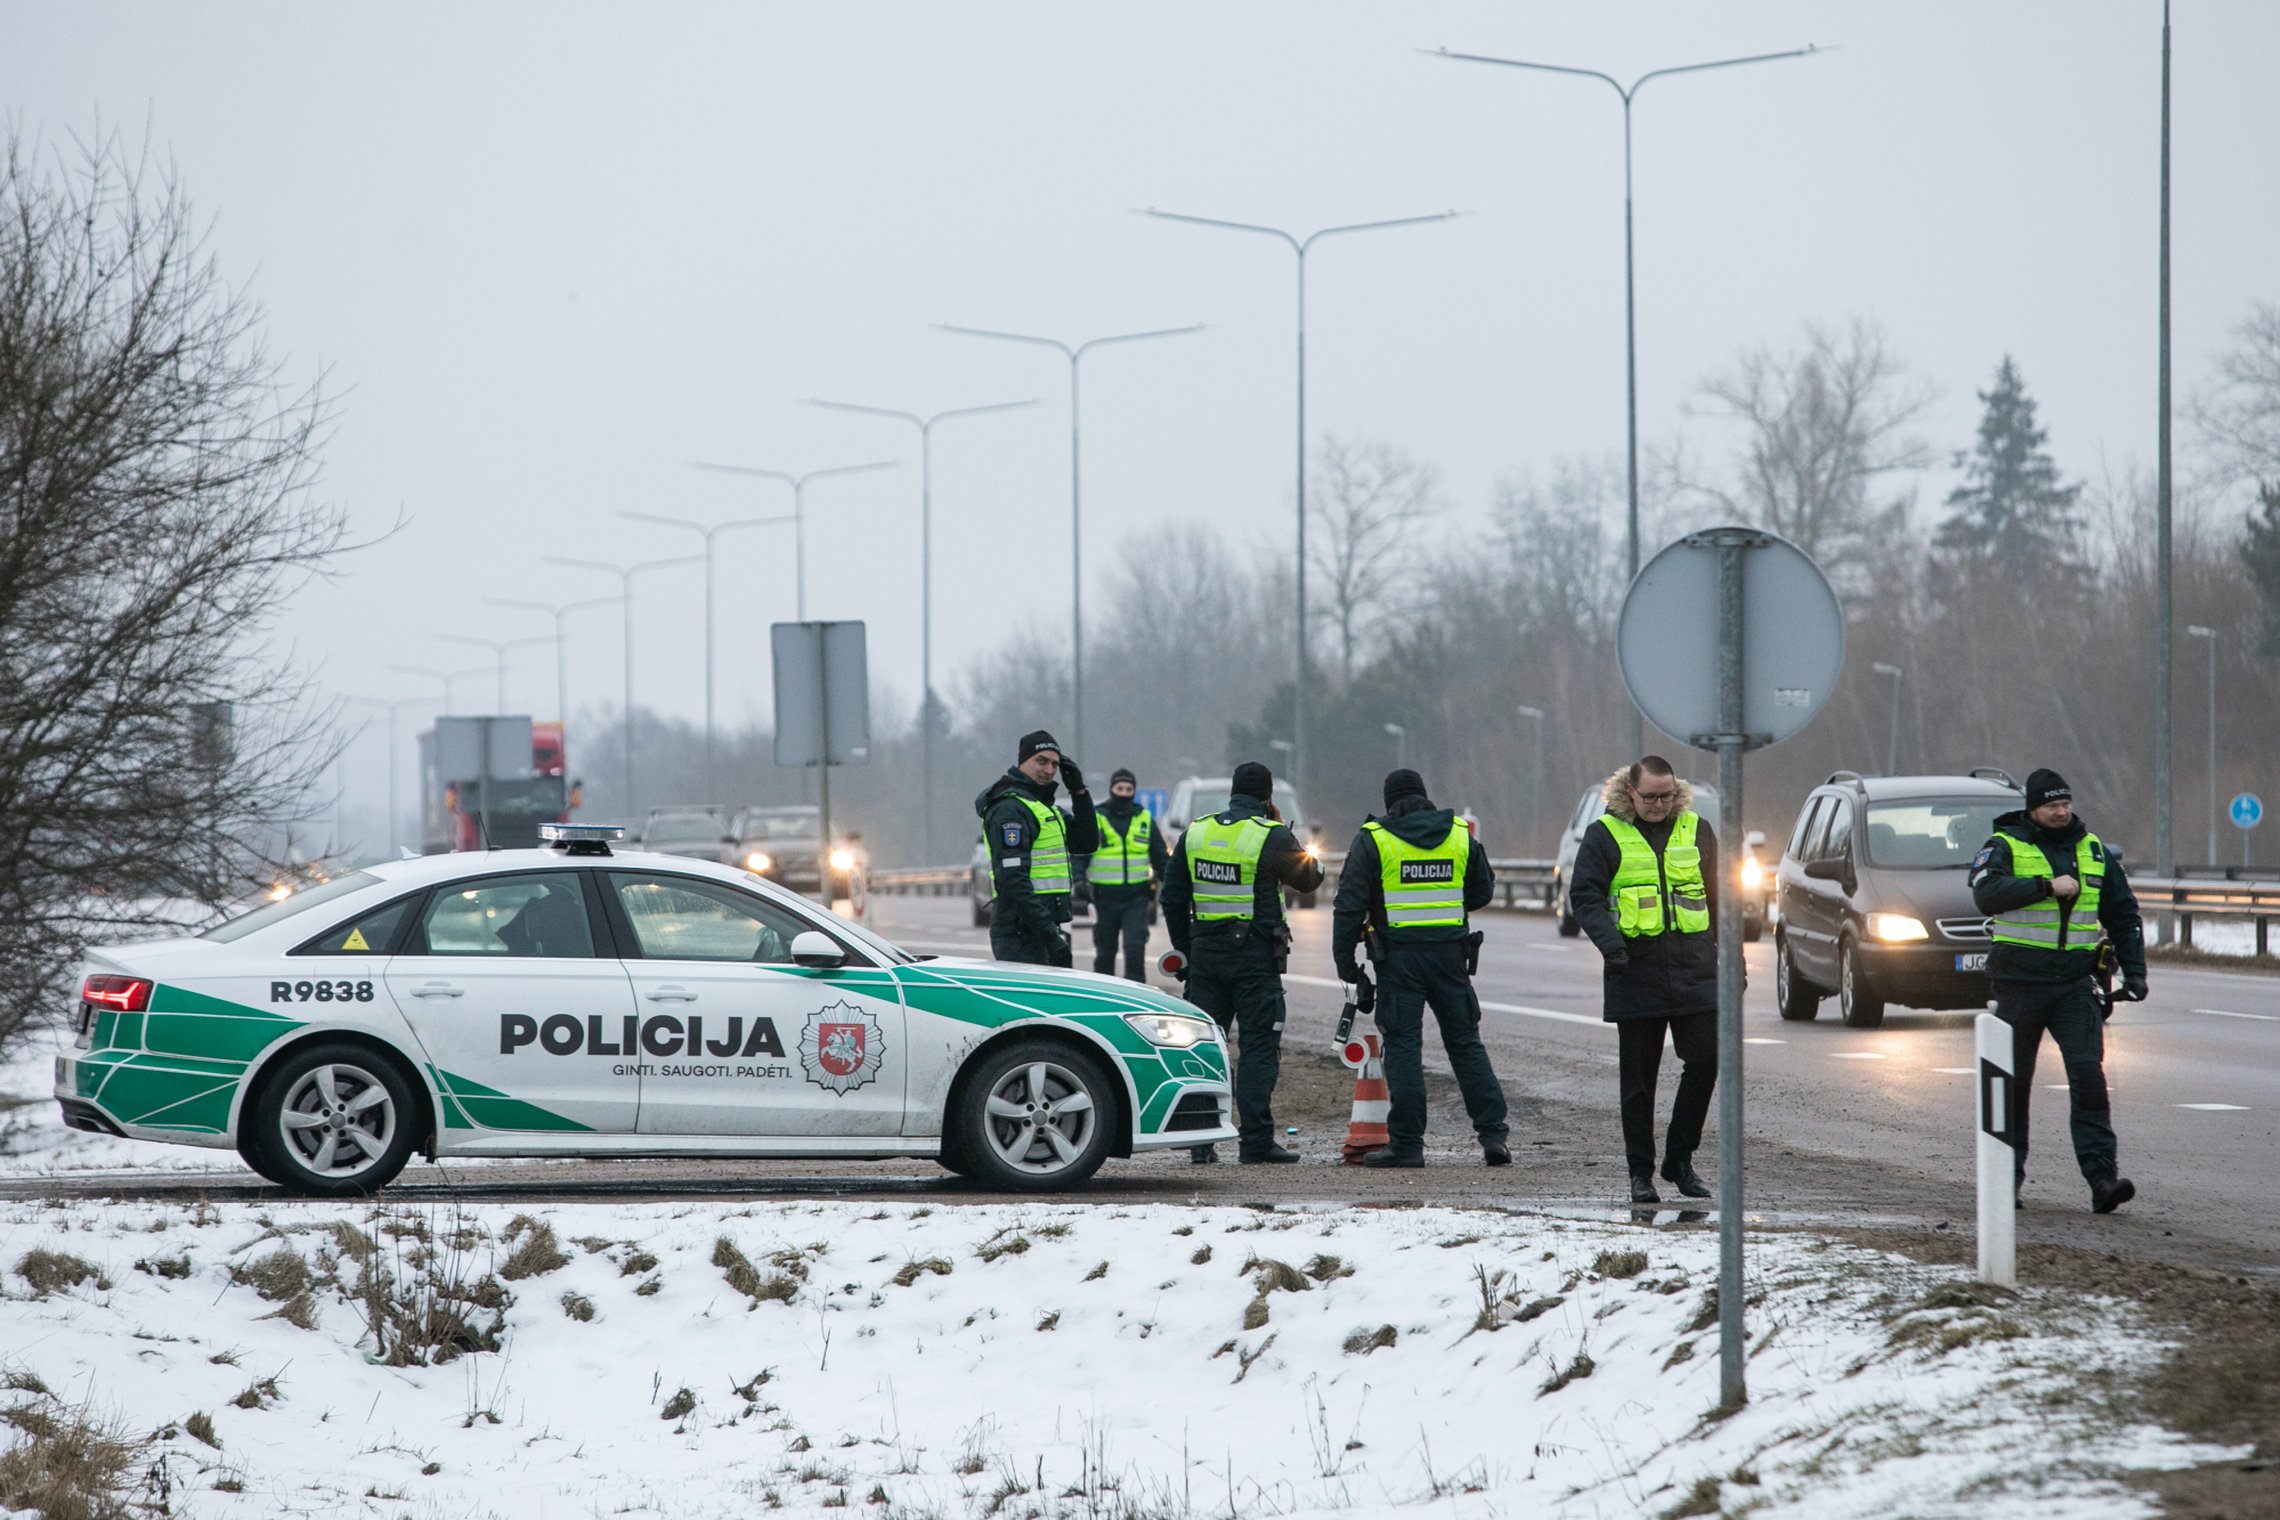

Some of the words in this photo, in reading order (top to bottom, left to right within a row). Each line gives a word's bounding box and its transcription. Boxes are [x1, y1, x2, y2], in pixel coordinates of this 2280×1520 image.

[1196, 861, 1237, 882] POLICIJA
[1402, 864, 1452, 878] POLICIJA
[1965, 955, 1986, 969] JG
[270, 980, 374, 1003] R9838
[500, 1013, 787, 1058] POLICIJA
[612, 1064, 657, 1077] GINTI.
[661, 1065, 733, 1078] SAUGOTI.
[736, 1063, 793, 1079] PADĖTI.
